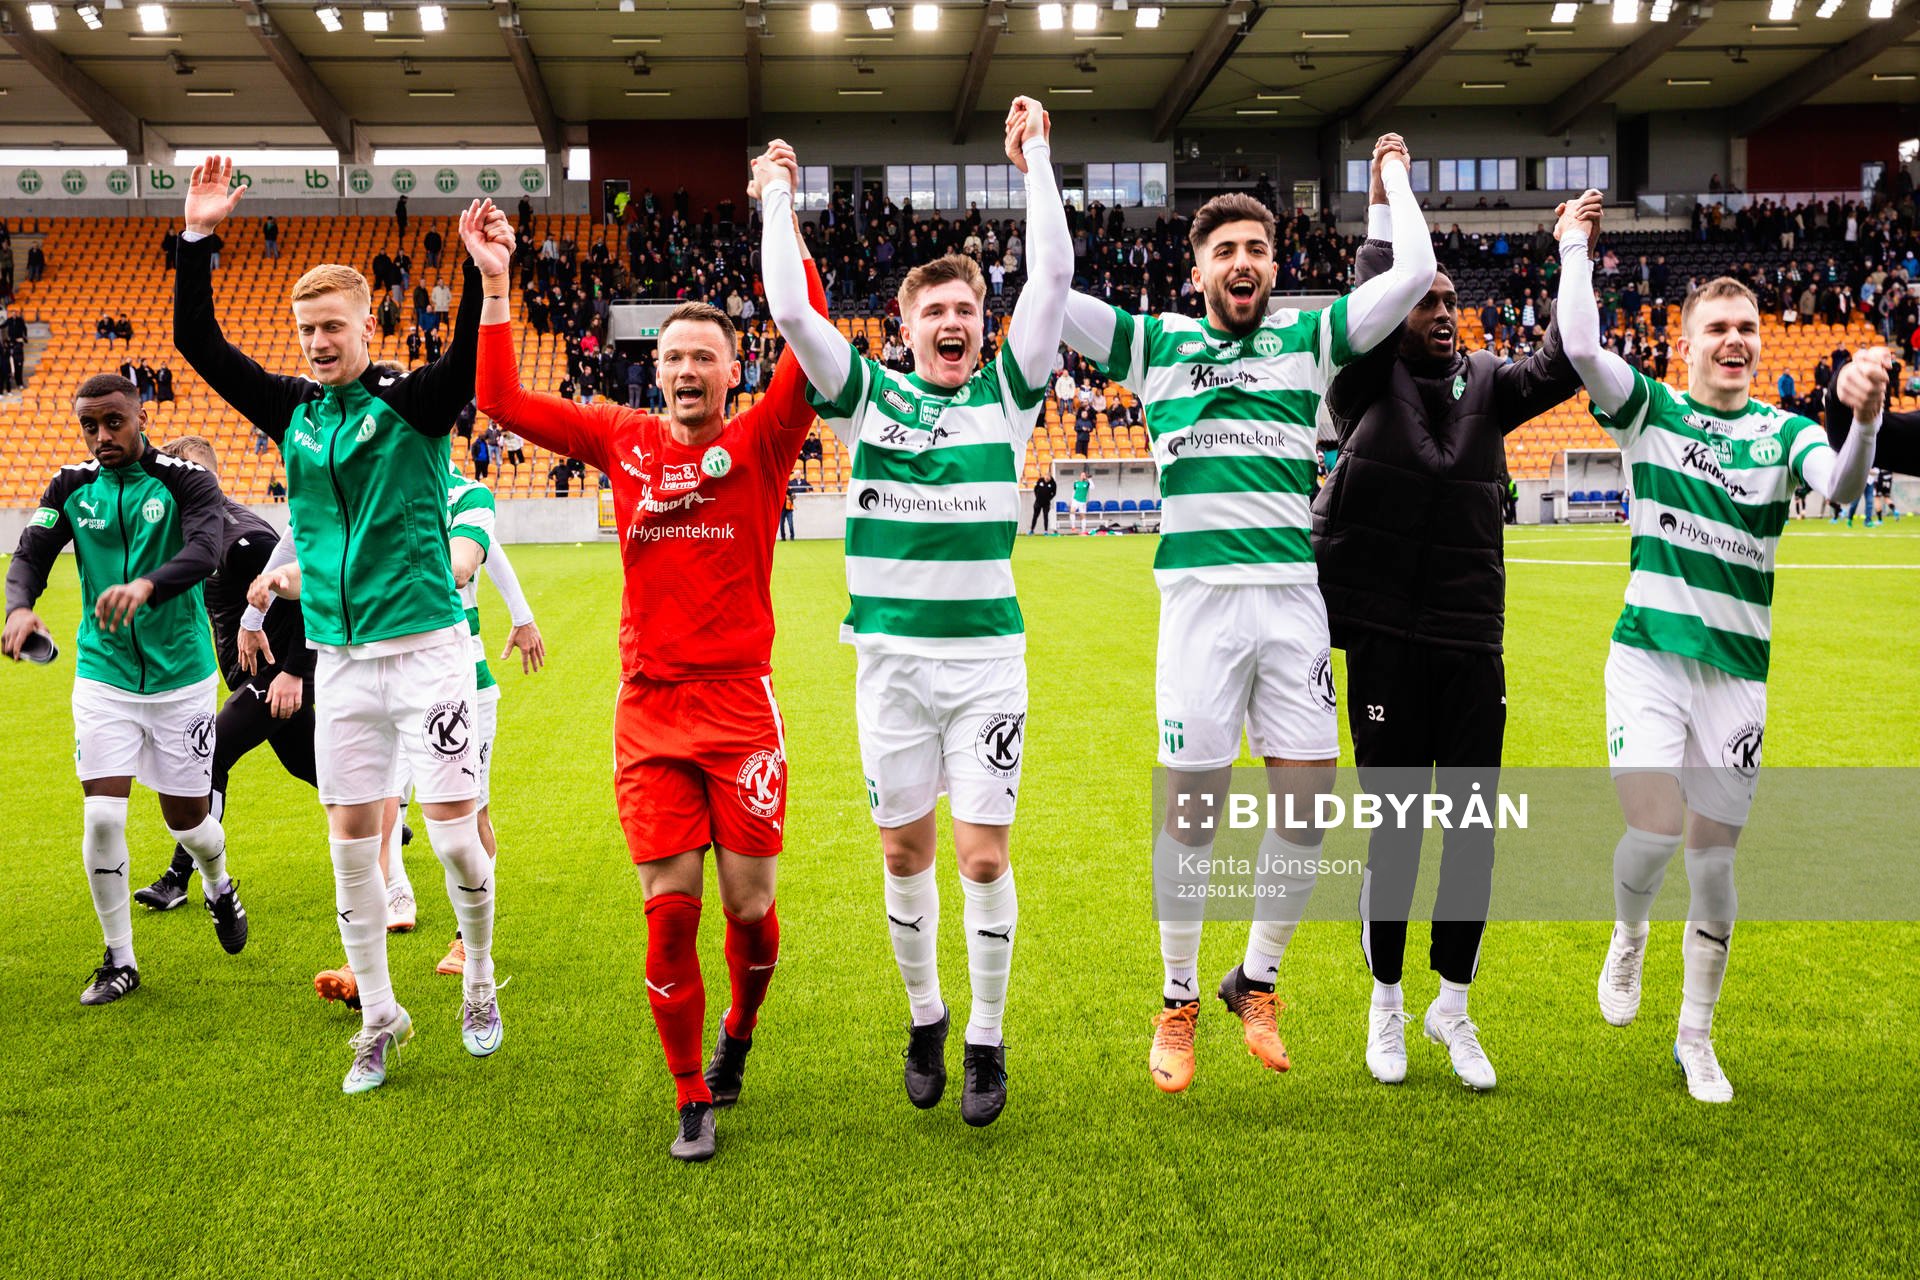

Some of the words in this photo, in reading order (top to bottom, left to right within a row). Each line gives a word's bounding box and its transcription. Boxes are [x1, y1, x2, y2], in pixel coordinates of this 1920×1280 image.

[151, 169, 175, 190] tb
[305, 169, 329, 189] tb
[666, 471, 683, 482] Bad
[682, 465, 697, 480] &
[883, 493, 987, 513] Hygienteknik
[632, 523, 735, 543] Hygienteknik
[1367, 704, 1385, 722] 32
